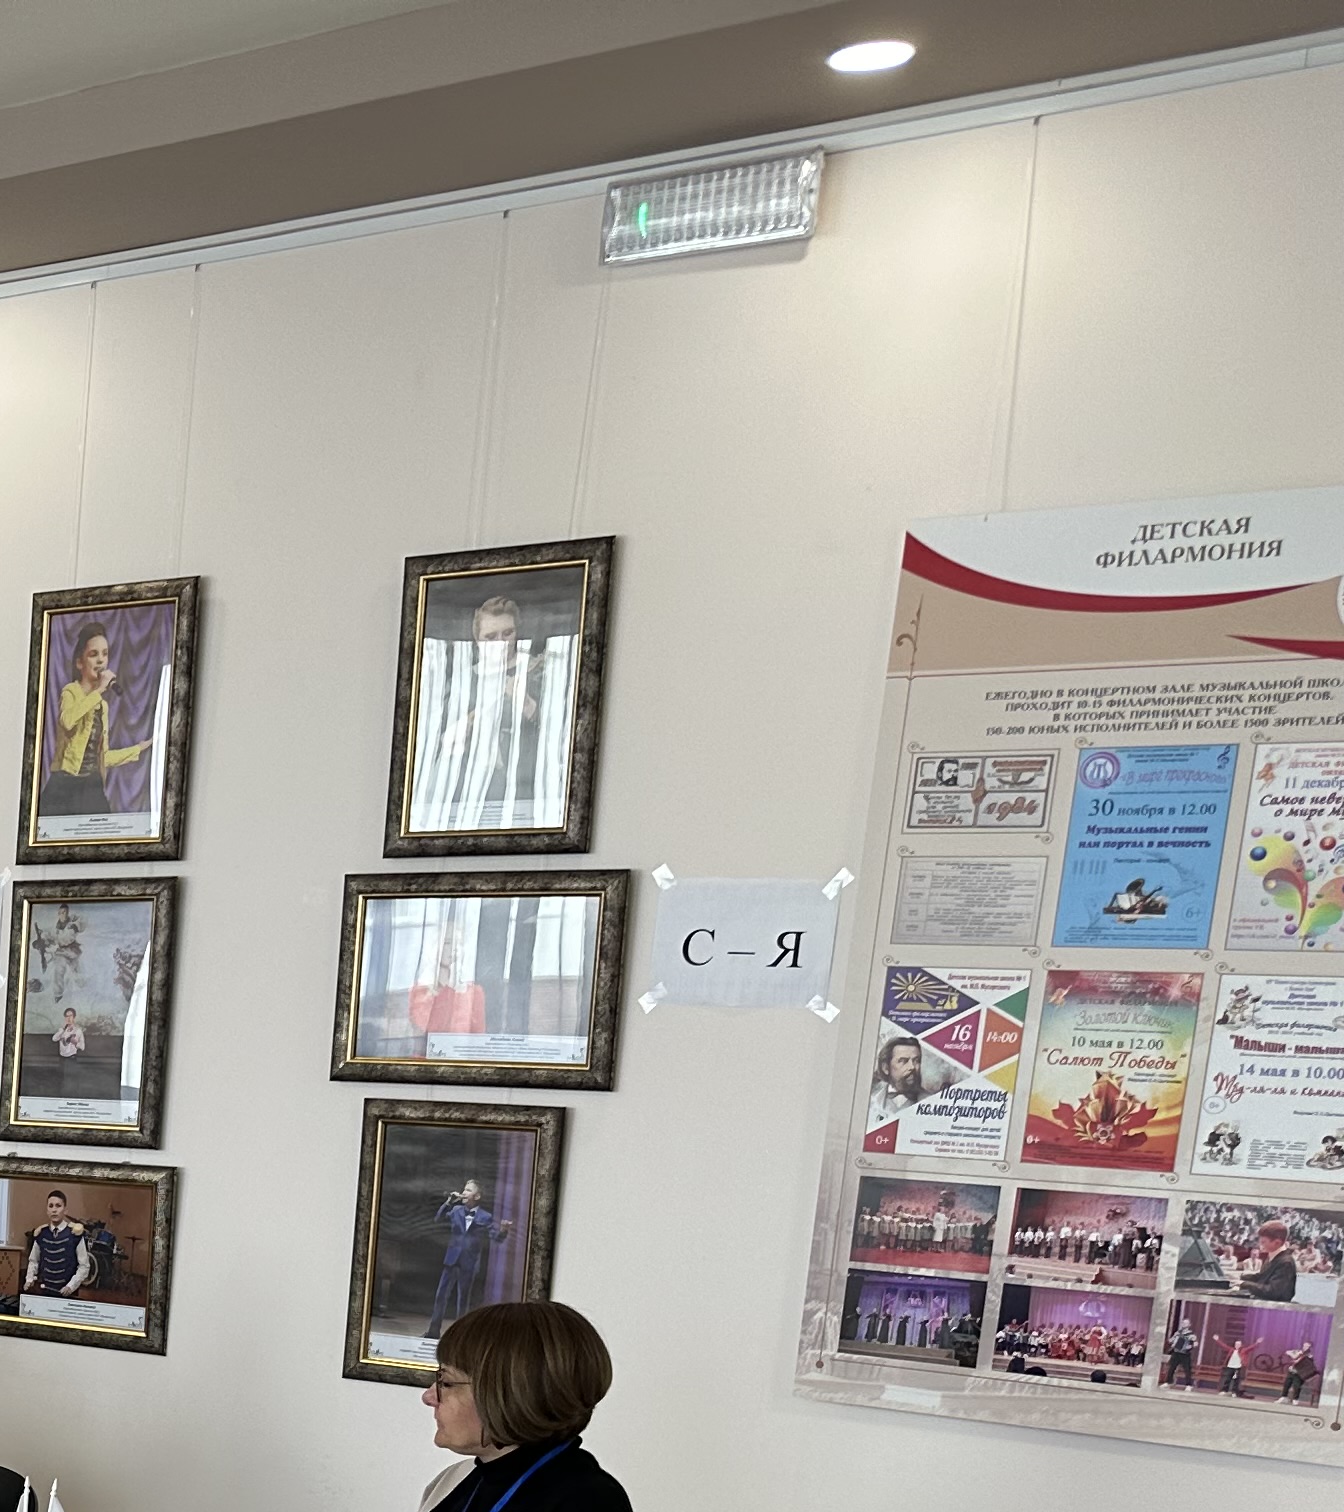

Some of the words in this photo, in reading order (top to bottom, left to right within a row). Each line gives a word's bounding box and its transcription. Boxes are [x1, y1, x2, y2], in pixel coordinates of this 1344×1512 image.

[1130, 516, 1252, 545] ДЕТСКАЯ
[1095, 539, 1283, 568] ФИЛАРМОНИЯ
[985, 689, 1053, 701] ЕЖЕГОДНО
[1067, 685, 1157, 699] КОНЦЕРТНОМ
[1159, 683, 1195, 694] ЗАЛЕ
[1199, 676, 1303, 693] МУЗЫКАЛЬНОЙ
[1005, 700, 1073, 712] ПРОХОДИТ
[1106, 693, 1244, 708] ФИЛАРМОНИЧЕСКИХ
[1063, 710, 1126, 721] КОТОРЫХ
[1129, 708, 1212, 719] ПРИНИМАЕТ
[1215, 705, 1278, 717] УЧАСТИЕ
[1027, 724, 1070, 735] ЮНЫХ
[1073, 718, 1178, 733] ИСПОЛНИТЕЛЕЙ
[1195, 718, 1240, 729] БОЛЕЕ
[1088, 798, 1114, 817] 30
[1117, 804, 1164, 818] ноября
[1168, 806, 1176, 815] в
[1180, 803, 1217, 816] 12.00
[1260, 793, 1306, 806] Самое
[1085, 825, 1170, 837] Музыкальные
[1172, 825, 1209, 834] гении
[1078, 840, 1100, 849] или
[1103, 840, 1144, 850] портал
[1157, 840, 1211, 849] вечность
[682, 928, 716, 967] С
[766, 930, 808, 969] Я
[951, 1024, 972, 1042] 16
[986, 1031, 1018, 1043] 14:00
[1071, 1035, 1086, 1047] 10
[1089, 1040, 1112, 1048] мая
[1116, 1041, 1124, 1049] в
[1129, 1037, 1164, 1050] 12.00
[1238, 1063, 1256, 1076] 14
[1259, 1067, 1287, 1077] мая
[1291, 1068, 1300, 1078] в
[939, 1087, 1009, 1105] Портреты
[916, 1102, 1007, 1124] композиторов
[875, 1135, 889, 1145] 0+
